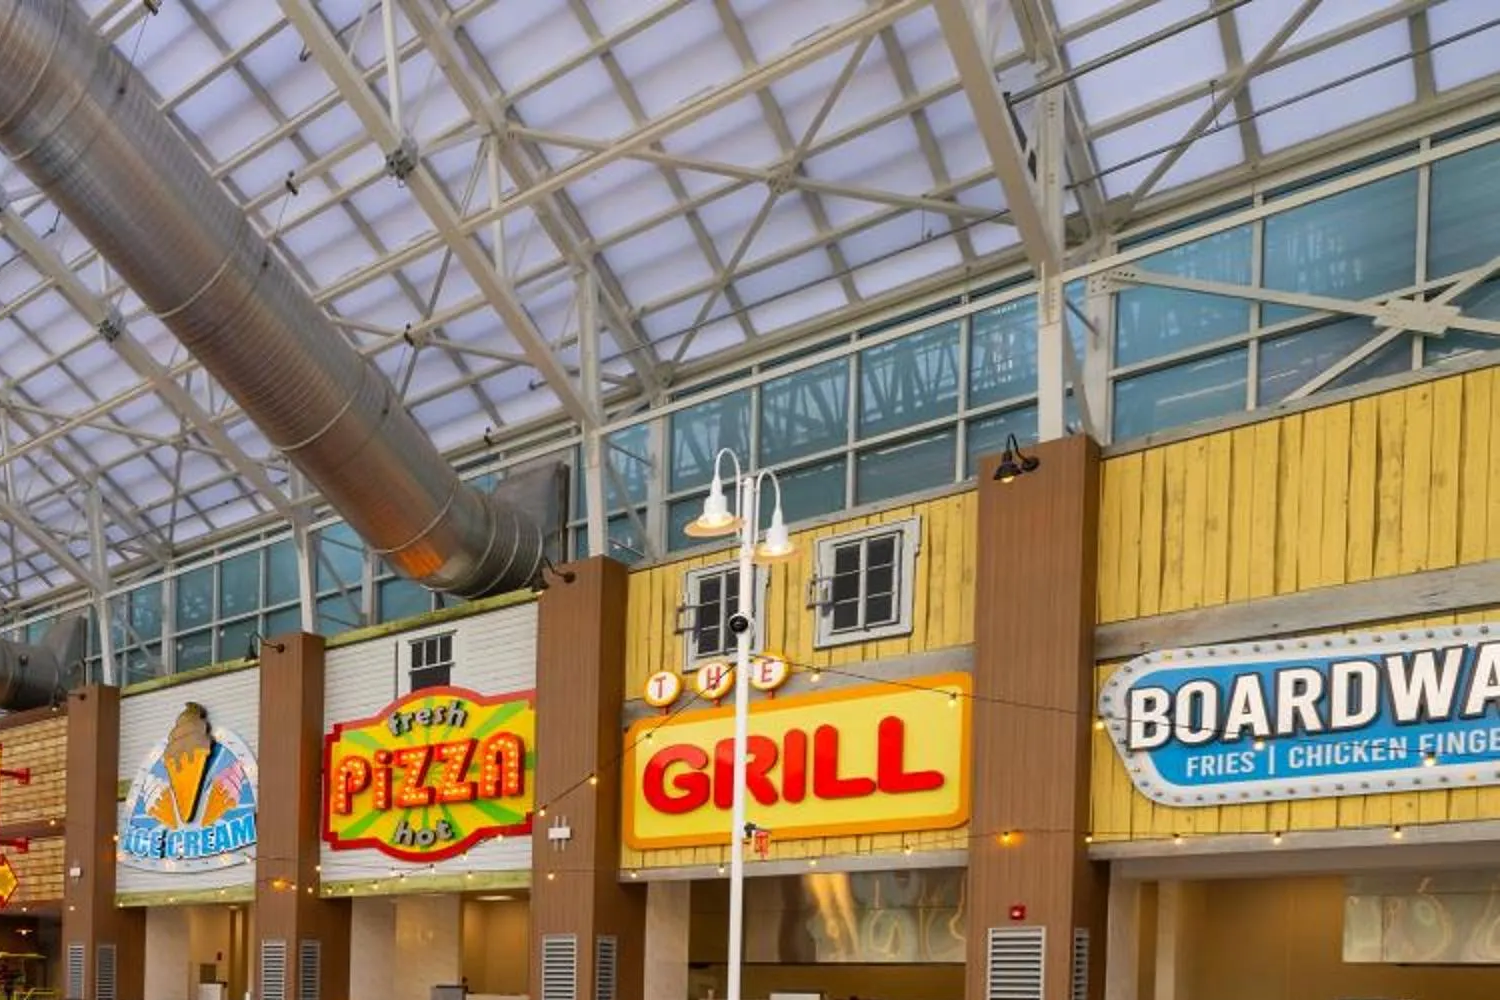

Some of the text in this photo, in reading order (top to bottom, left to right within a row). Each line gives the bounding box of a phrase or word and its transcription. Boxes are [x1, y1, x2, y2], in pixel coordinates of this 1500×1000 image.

[653, 660, 774, 699] THE
[388, 702, 467, 736] fresh
[643, 715, 945, 815] GRILL
[1186, 752, 1256, 778] FRIES
[1288, 736, 1408, 769] CHICKEN
[123, 813, 257, 858] ICE CREAM
[393, 819, 455, 847] hot
